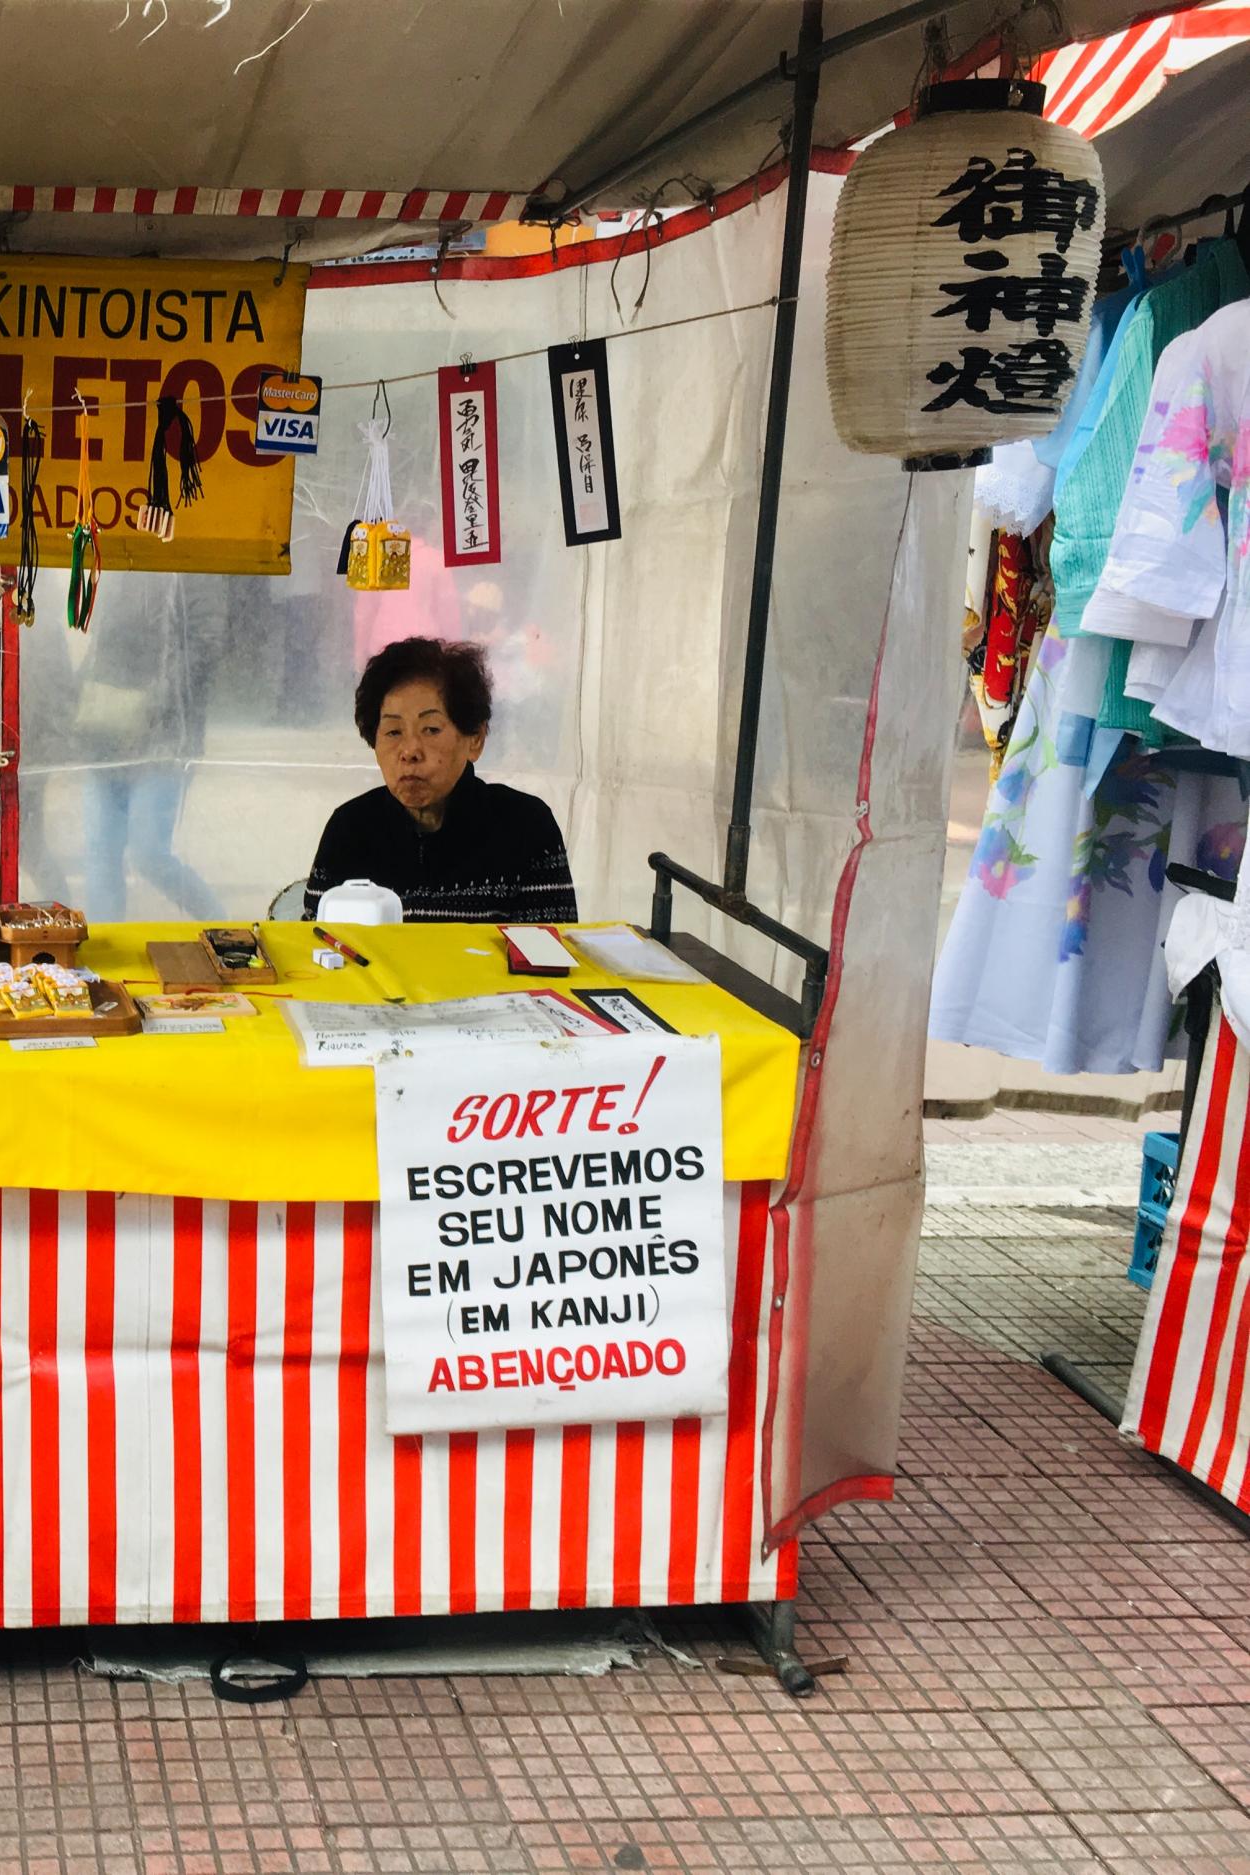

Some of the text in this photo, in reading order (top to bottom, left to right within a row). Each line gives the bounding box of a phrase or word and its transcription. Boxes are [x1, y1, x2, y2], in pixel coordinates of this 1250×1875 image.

[262, 386, 318, 402] MasterCard
[264, 418, 314, 440] VISA
[447, 1056, 666, 1144] SORTE!
[407, 1145, 705, 1200] ESCREVEMOS
[438, 1195, 661, 1247] SEU NOME
[407, 1234, 700, 1297] EM JAPONÊS
[447, 1284, 660, 1343] (EM KANJI)
[428, 1338, 686, 1392] ABENÇOADO
